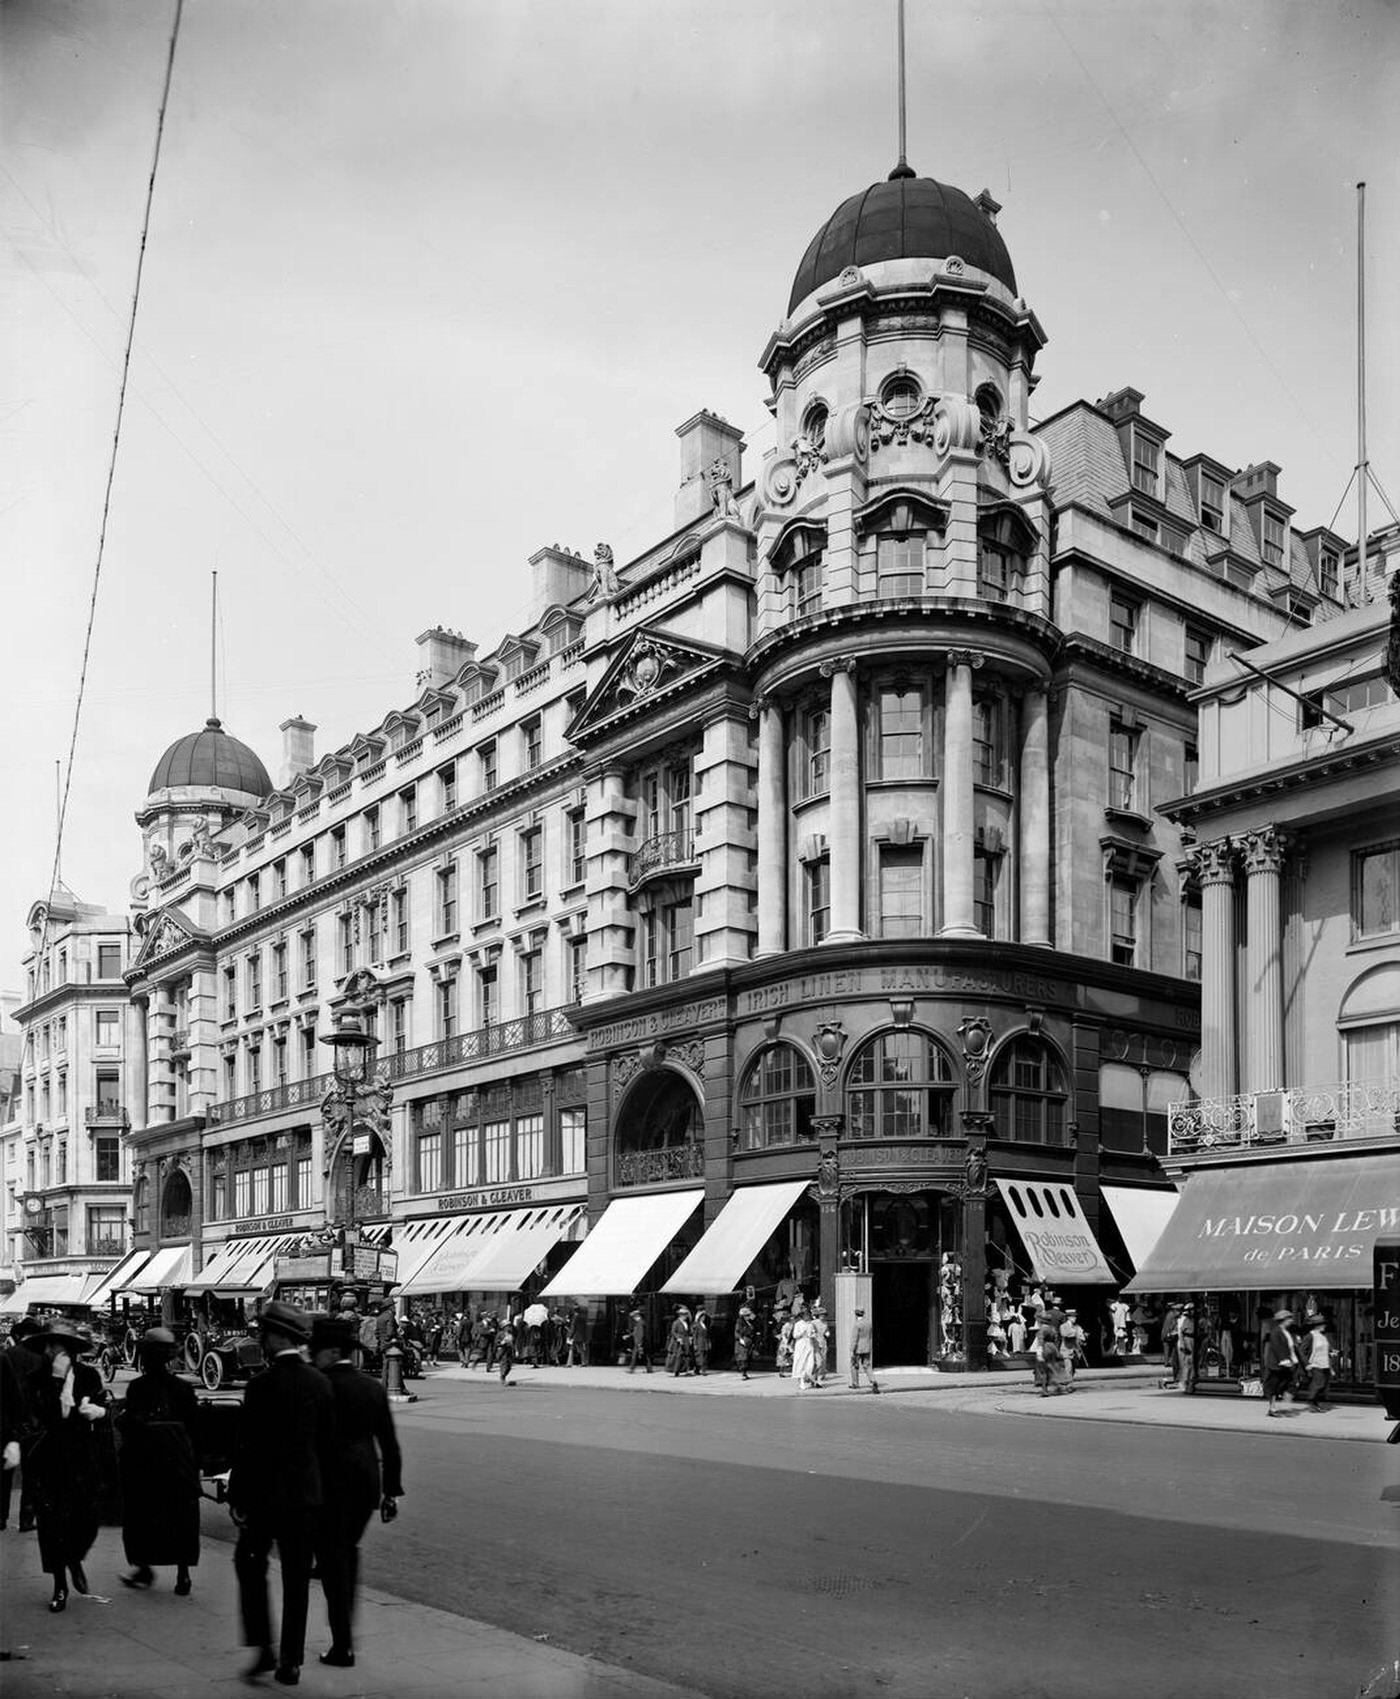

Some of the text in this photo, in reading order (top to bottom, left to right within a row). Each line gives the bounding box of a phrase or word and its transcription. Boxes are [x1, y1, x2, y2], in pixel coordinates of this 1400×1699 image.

[746, 981, 790, 1012] IRISH
[799, 969, 862, 1000] LINEN
[879, 967, 1057, 1001] MANUFACTURERS
[589, 1016, 647, 1049] ROBINSON
[649, 1015, 659, 1034] &
[438, 1194, 479, 1210] ROBINSON
[490, 1188, 532, 1204] CLEAVER
[1197, 1212, 1325, 1239] MAISON
[1024, 1231, 1091, 1256] Robinson
[1243, 1244, 1365, 1262] de PARIS
[1377, 1309, 1400, 1329] Je
[1383, 1353, 1400, 1373] 18
